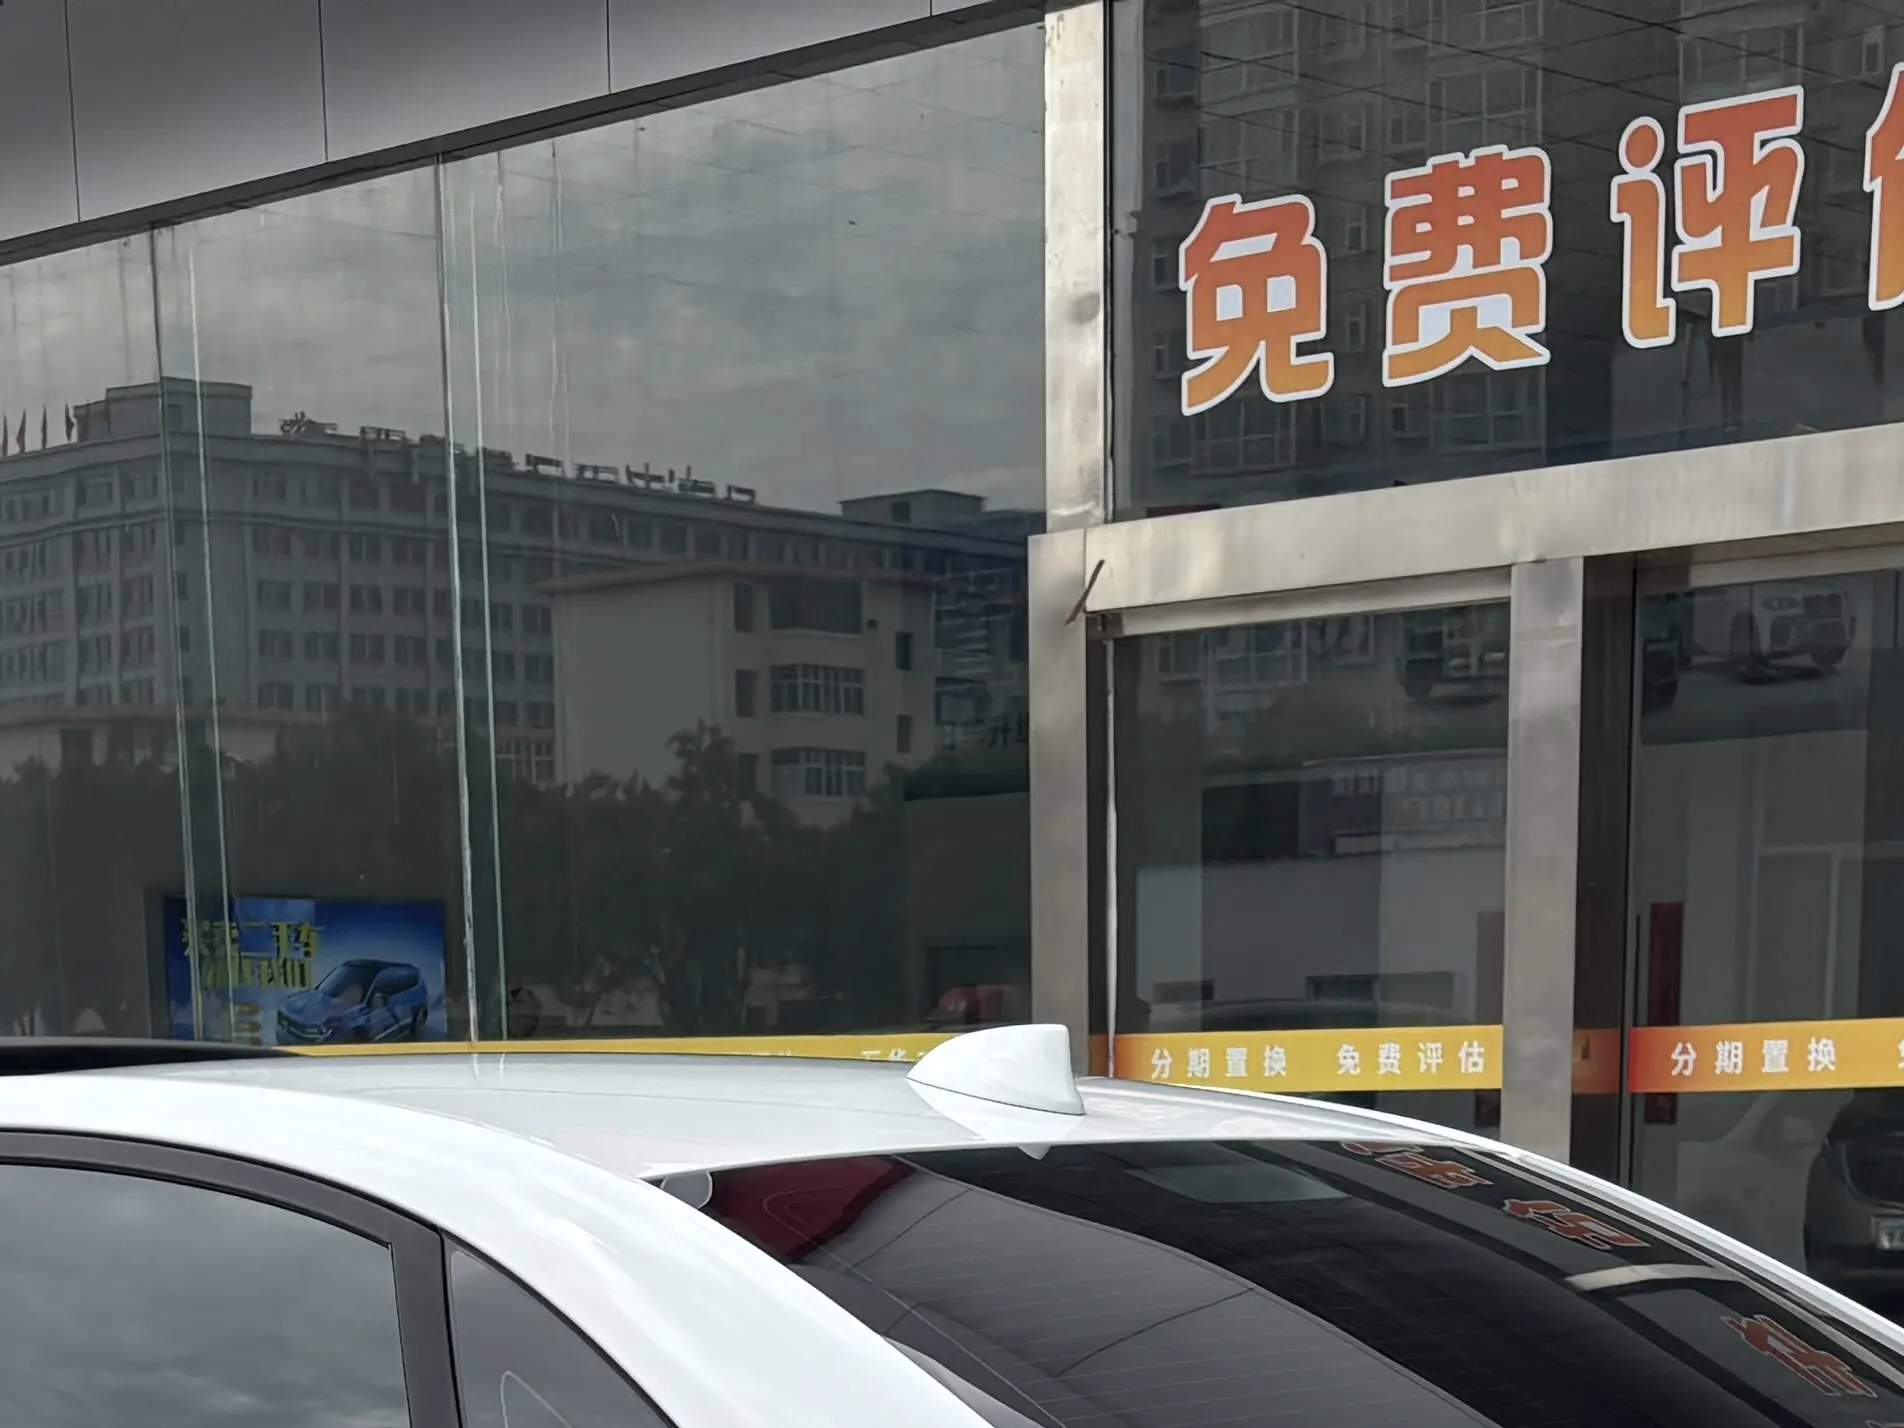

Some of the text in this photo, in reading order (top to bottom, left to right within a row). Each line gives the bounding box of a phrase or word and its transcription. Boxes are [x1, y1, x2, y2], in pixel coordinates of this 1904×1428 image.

[1151, 1040, 1485, 1078] 分期置换 免费评估
[1671, 1038, 1836, 1075] 分期置换
